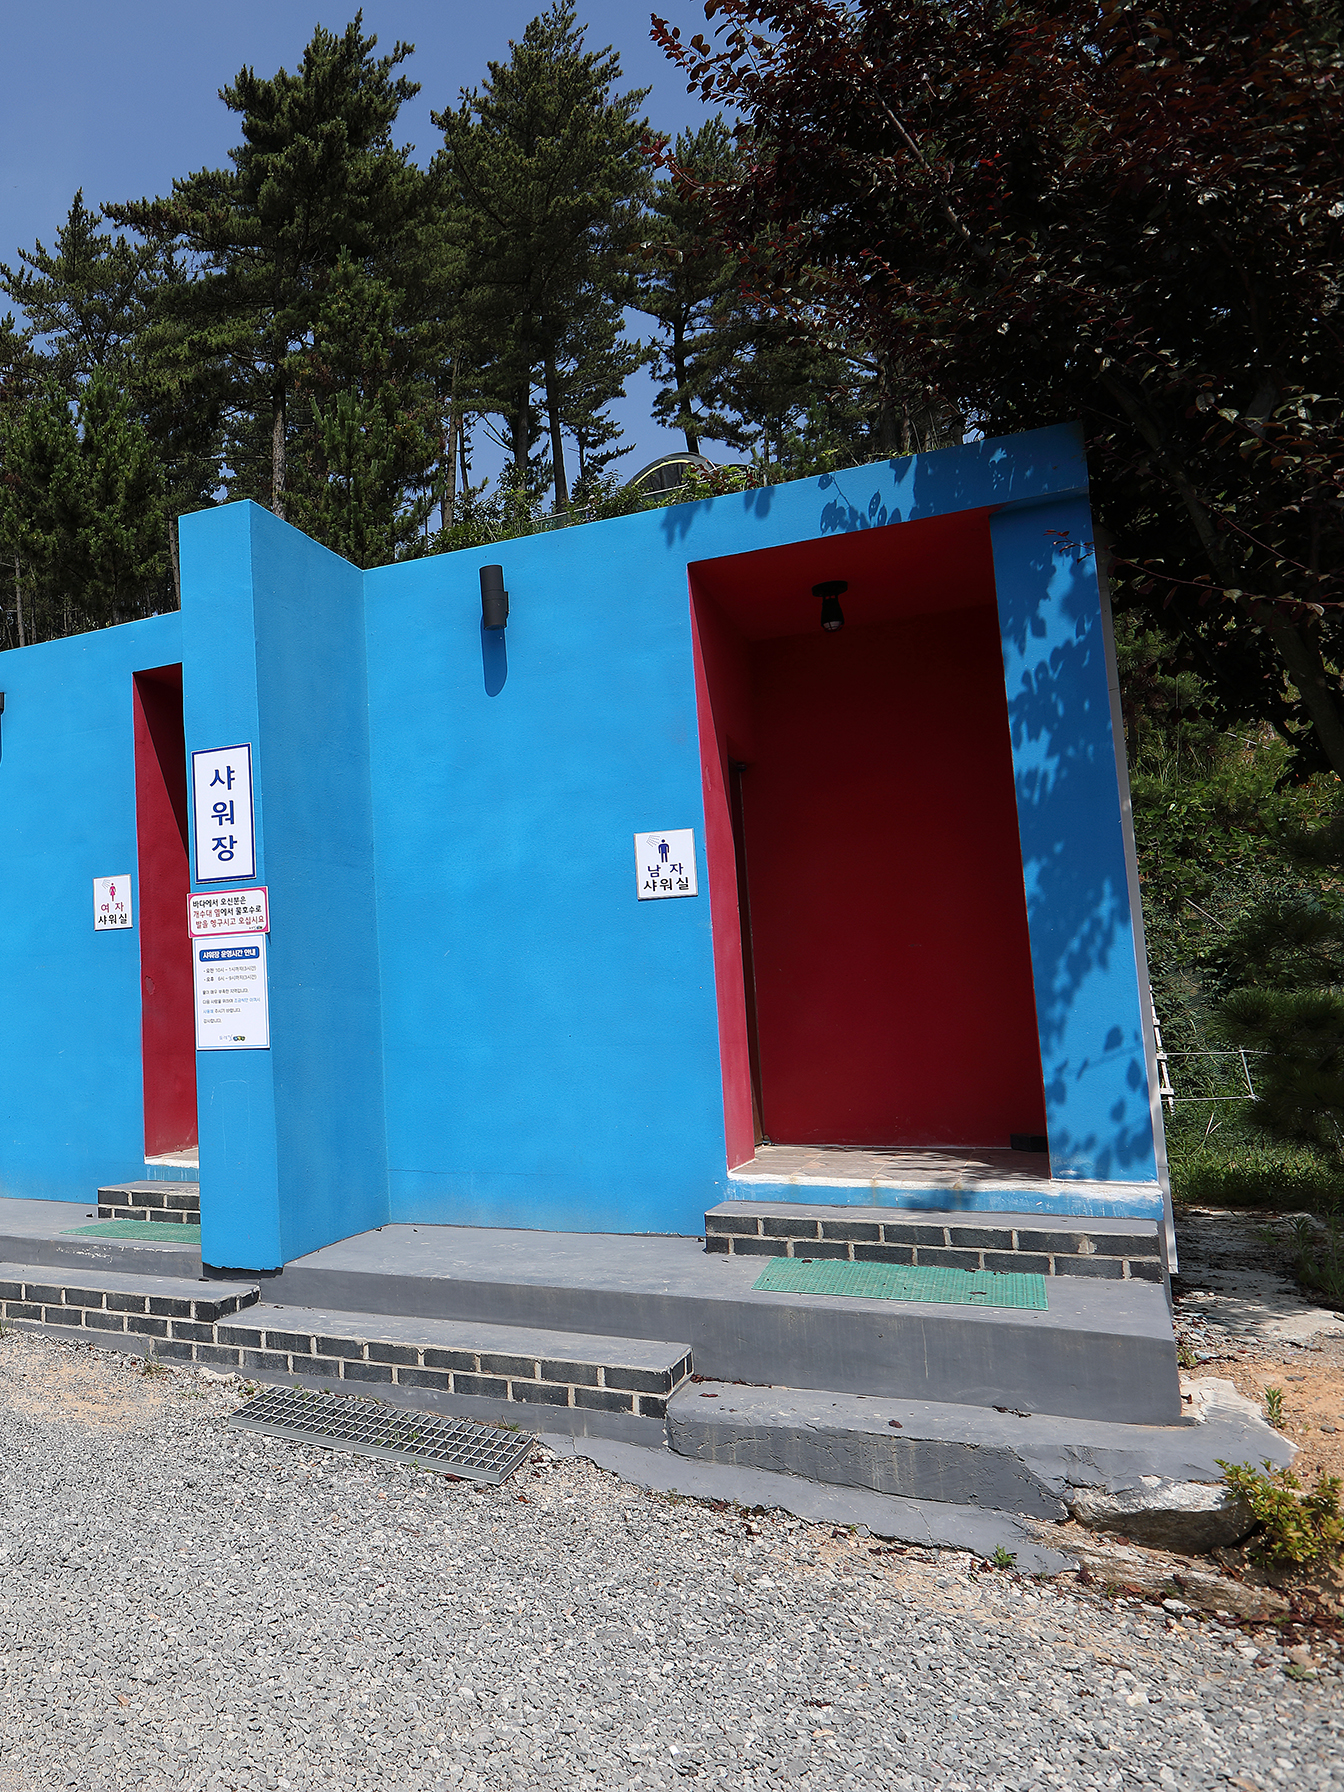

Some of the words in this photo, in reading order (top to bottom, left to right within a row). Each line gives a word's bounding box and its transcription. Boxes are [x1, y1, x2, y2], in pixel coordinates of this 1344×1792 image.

[209, 765, 238, 862] 샤워장
[643, 876, 689, 892] 샤워실
[192, 898, 219, 909] 바다에서
[220, 895, 247, 906] 오신분은
[98, 913, 128, 925] 샤워실
